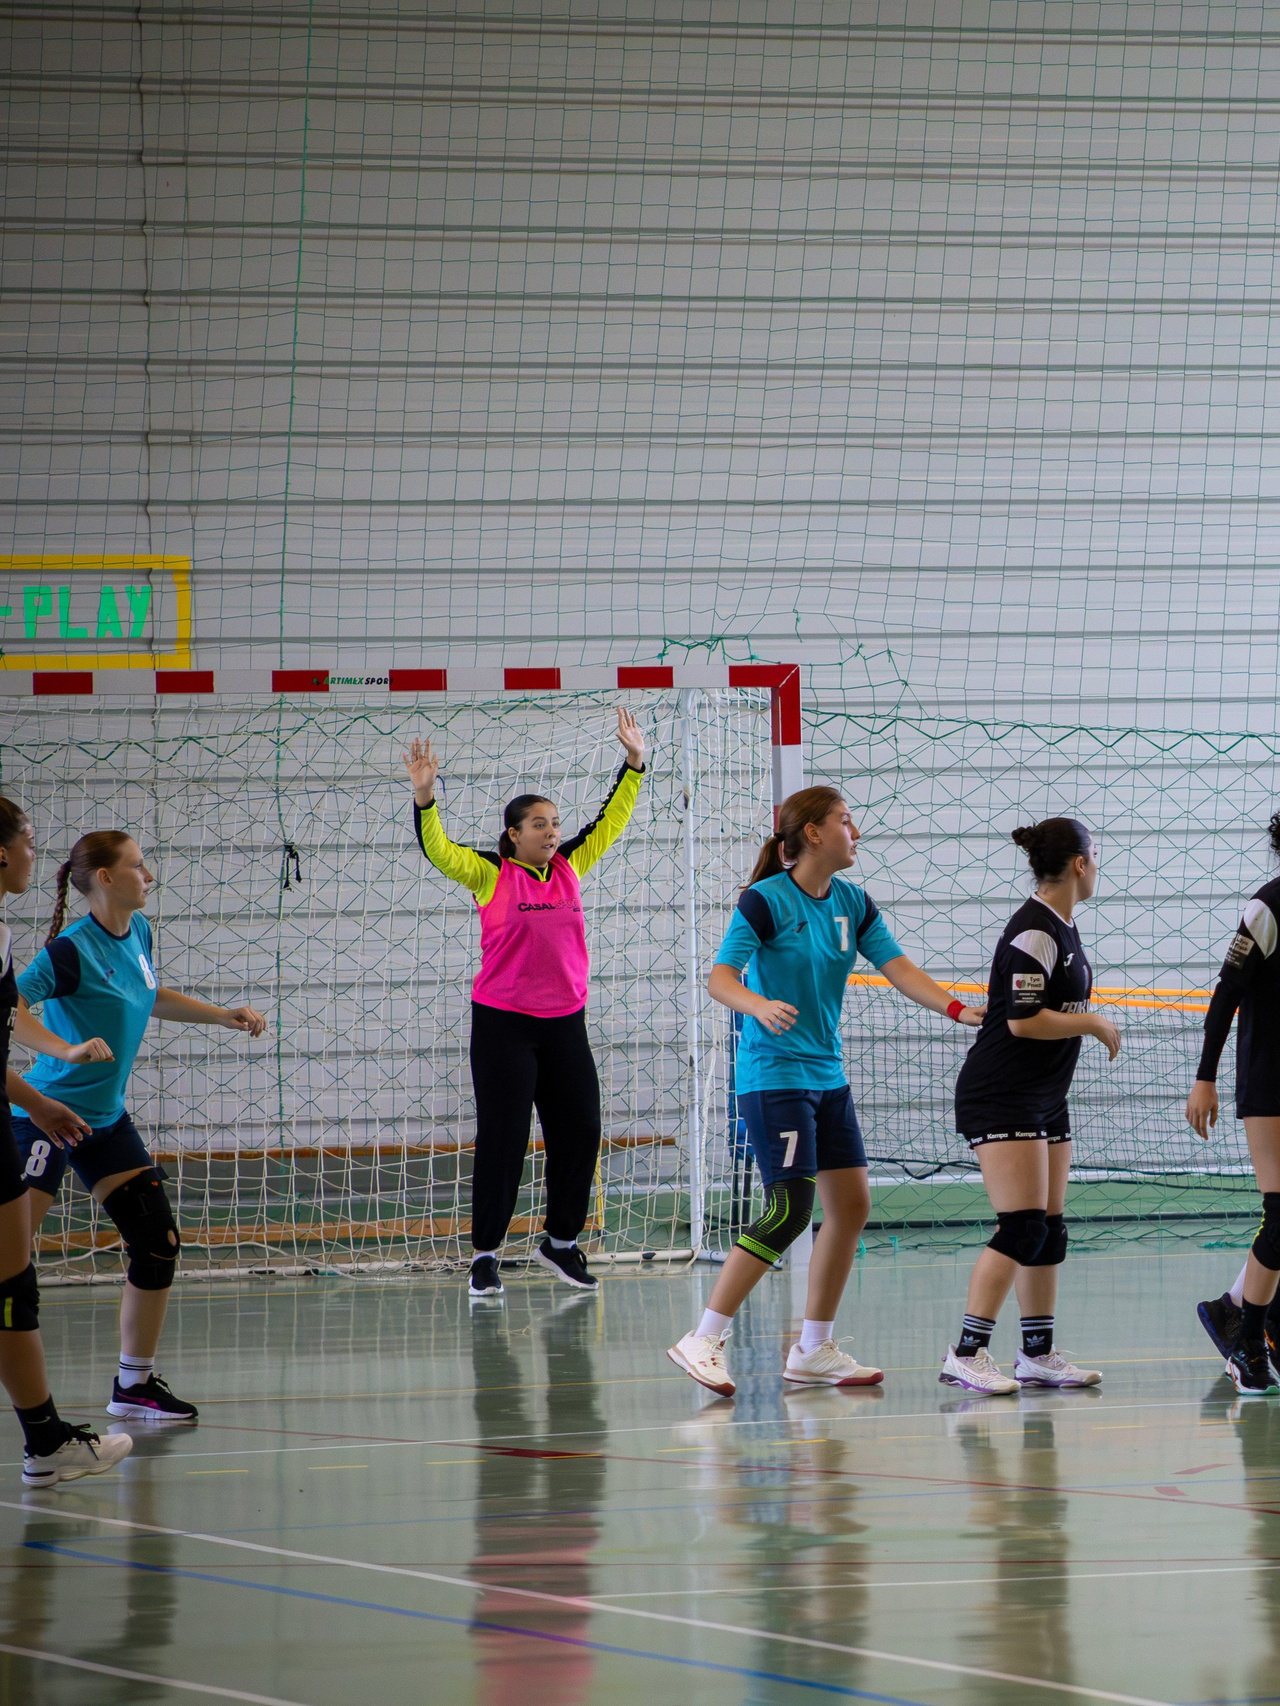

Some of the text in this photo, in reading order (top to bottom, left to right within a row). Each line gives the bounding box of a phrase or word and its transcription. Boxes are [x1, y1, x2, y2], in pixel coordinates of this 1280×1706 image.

[323, 676, 394, 685] ARTIMEX SPORT
[833, 916, 849, 952] 7
[138, 953, 156, 990] 8
[779, 1130, 799, 1168] 7
[987, 1132, 1009, 1140] Kempa
[1015, 1130, 1037, 1138] Kempa
[25, 1139, 51, 1178] 8
